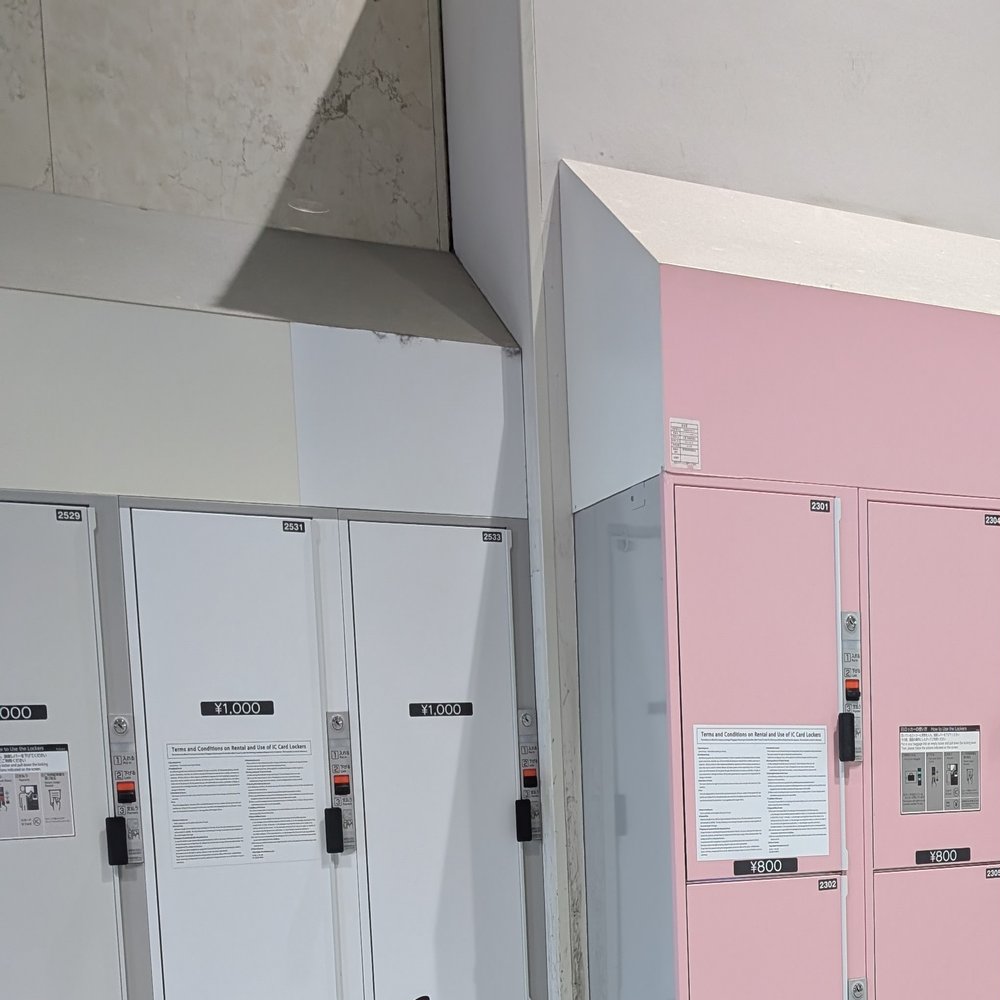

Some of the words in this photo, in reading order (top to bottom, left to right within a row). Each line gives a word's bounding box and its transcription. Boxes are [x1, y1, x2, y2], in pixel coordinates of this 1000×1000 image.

[811, 500, 829, 511] 2301
[58, 511, 81, 520] 2529
[985, 515, 1000, 525] 2304
[284, 522, 303, 531] 2531
[484, 533, 502, 541] 2533
[930, 849, 957, 863] ¥800
[750, 859, 782, 873] ¥800
[819, 879, 837, 890] 2302
